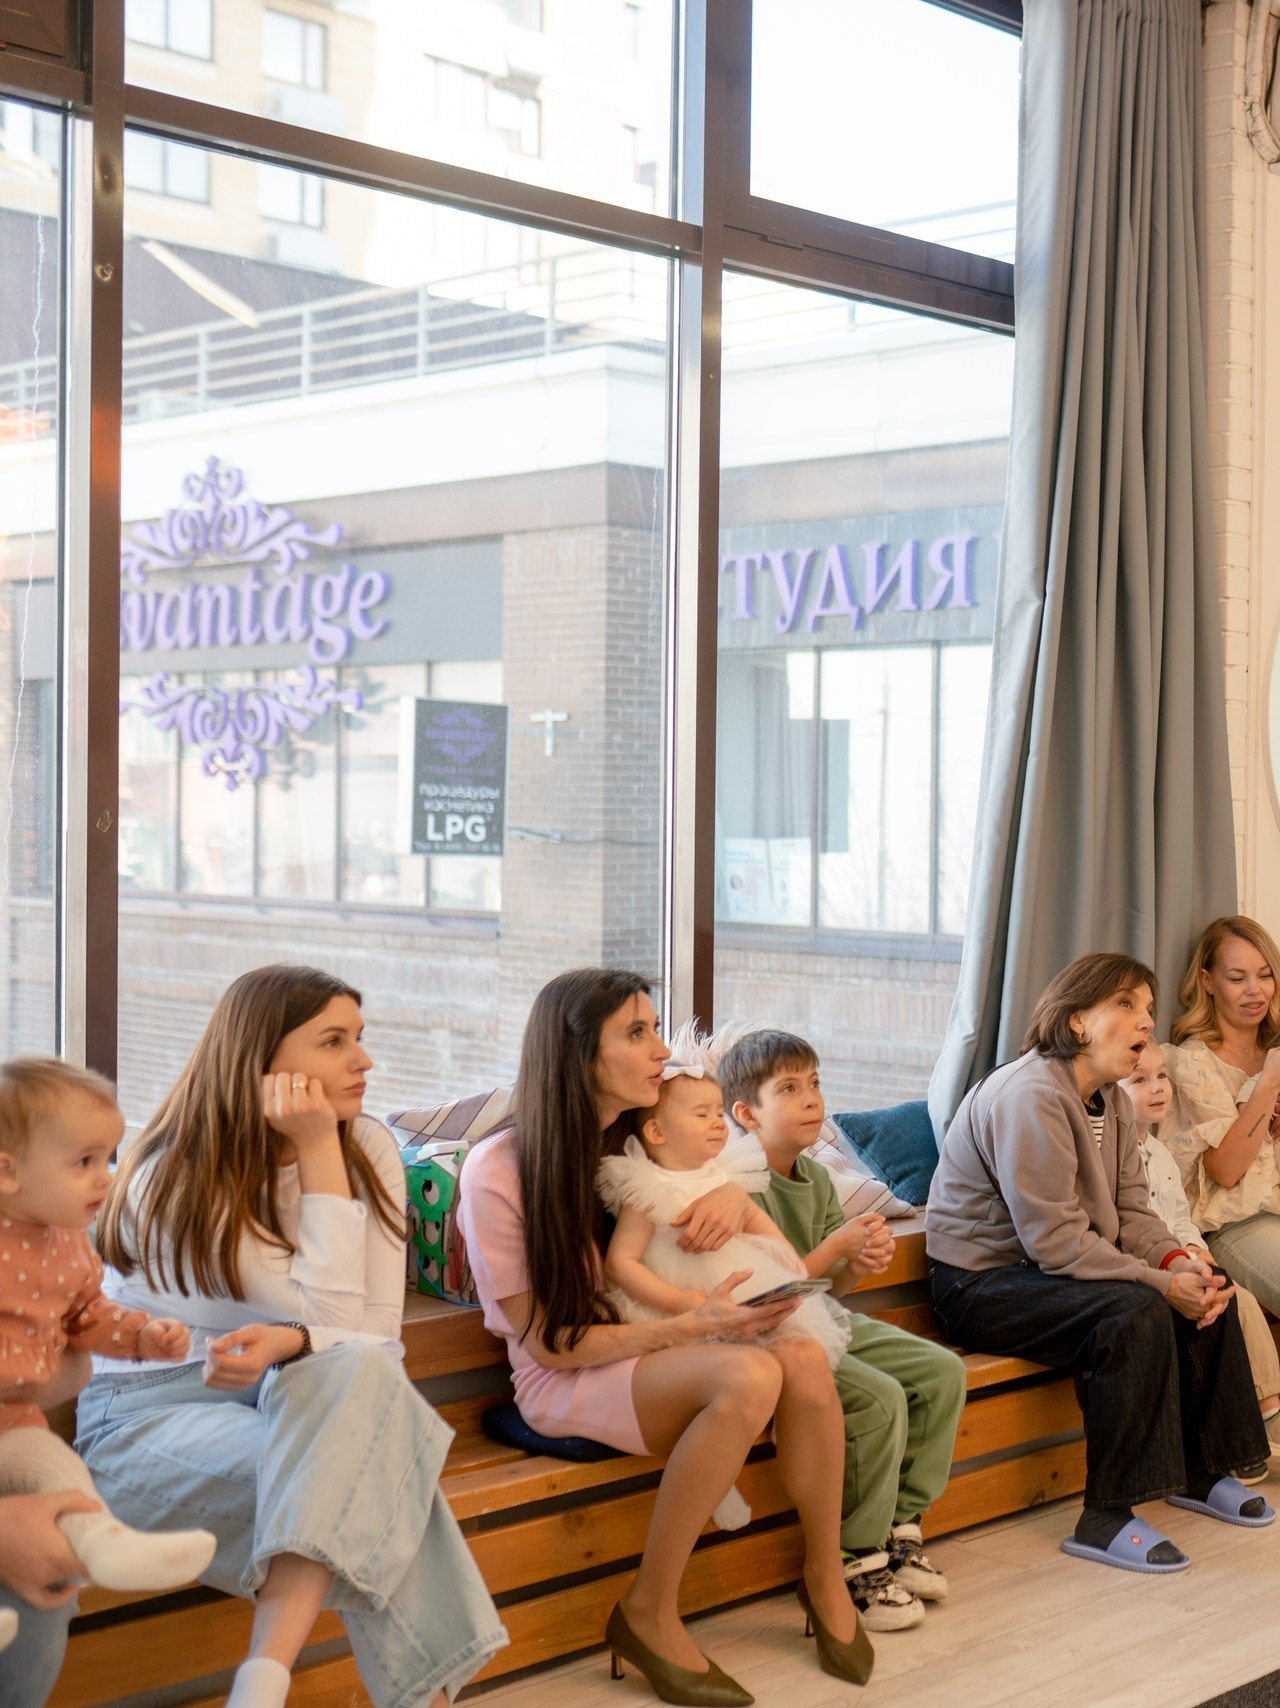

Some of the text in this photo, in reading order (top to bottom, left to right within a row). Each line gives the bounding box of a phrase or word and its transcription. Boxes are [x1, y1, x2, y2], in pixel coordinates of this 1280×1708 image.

[120, 563, 390, 664] vantage
[719, 534, 977, 632] ТУДИЯ
[426, 813, 487, 842] LPG
